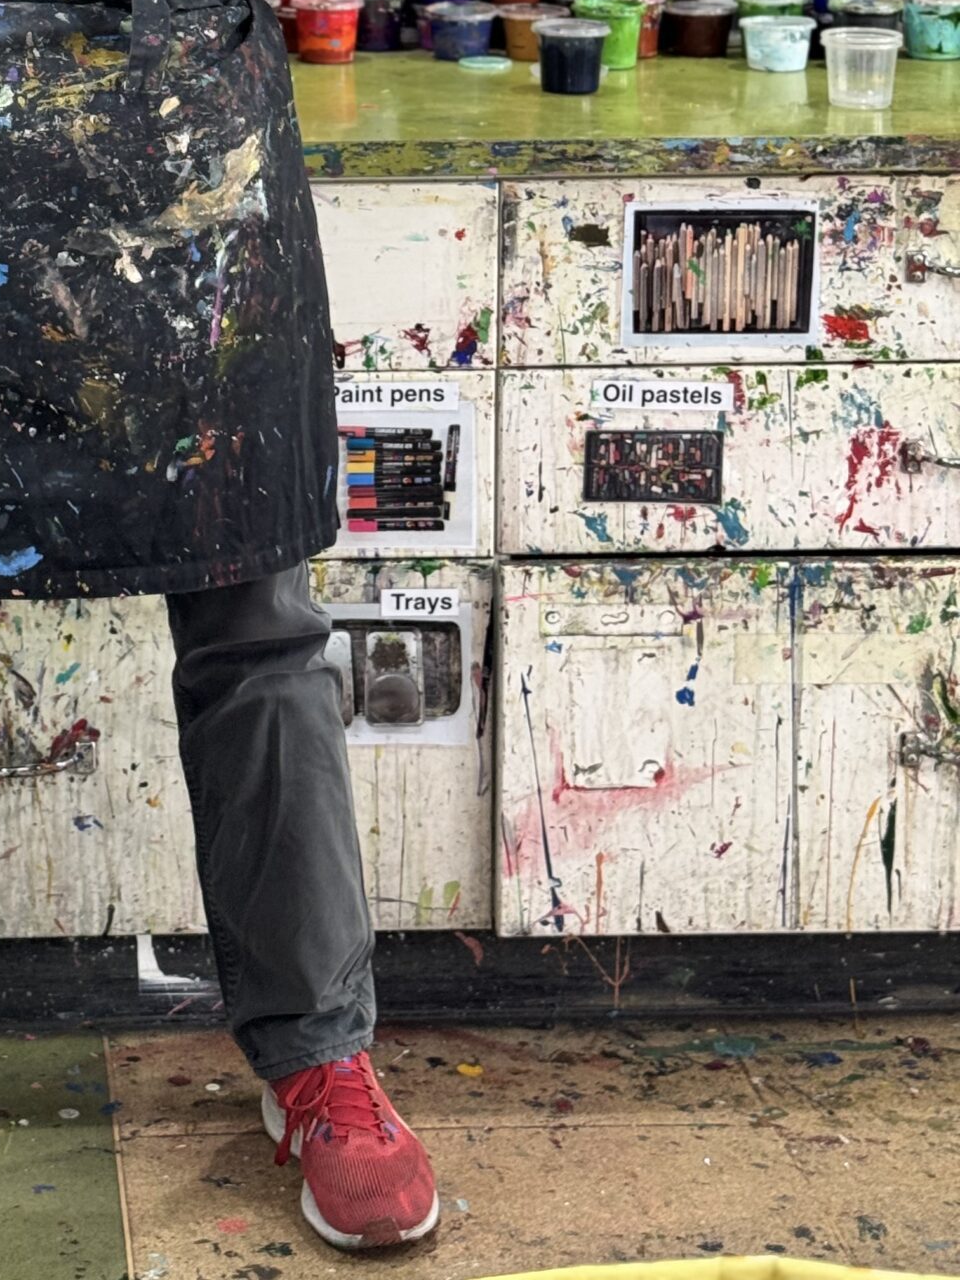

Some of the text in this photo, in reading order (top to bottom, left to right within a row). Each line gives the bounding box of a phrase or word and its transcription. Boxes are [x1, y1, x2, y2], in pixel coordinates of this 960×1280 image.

[391, 387, 445, 407] pens
[603, 384, 722, 407] Oil pastels
[390, 593, 452, 614] Trays
